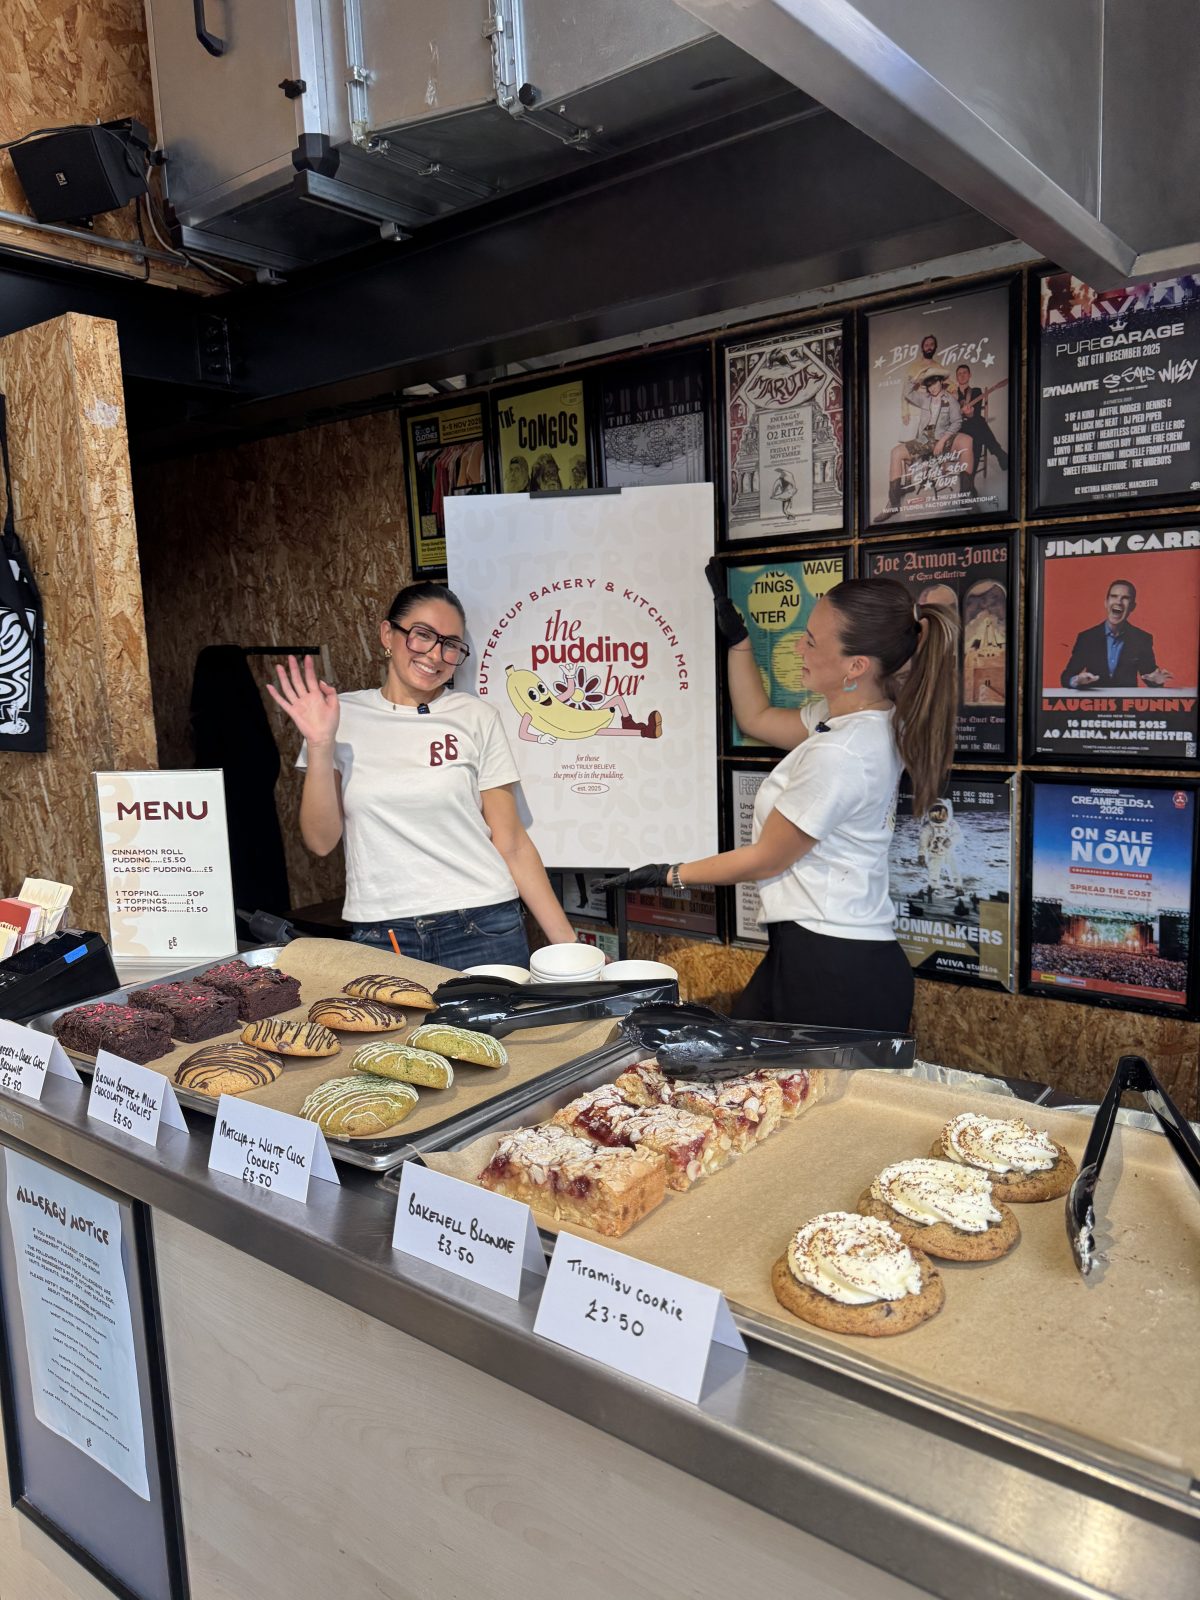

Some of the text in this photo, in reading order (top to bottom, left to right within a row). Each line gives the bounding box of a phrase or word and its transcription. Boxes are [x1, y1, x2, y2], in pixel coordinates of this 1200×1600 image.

[1077, 342, 1160, 368] SAT 6TH DECEMBER 2025
[498, 405, 516, 429] THE
[1064, 413, 1070, 422] 3
[1070, 412, 1077, 421] OF
[518, 410, 578, 451] CONGOS
[766, 426, 804, 441] O2 RITZ
[1045, 530, 1200, 557] JIMMY CARR
[803, 560, 844, 576] WAVE
[873, 546, 1008, 576] Joe Armon-Jones
[780, 594, 800, 608] AU
[480, 578, 690, 695] BUTTERCUP BAKERY & KITCHEN MCR
[545, 609, 582, 642] the
[531, 636, 648, 672] pudding
[604, 664, 645, 697] bar
[1042, 698, 1197, 712] LAUGHS FUNNY
[1043, 730, 1194, 742] AO ARENA, MANCHESTER
[1067, 720, 1168, 730] 16 DECEMBER 2025
[576, 754, 600, 763] for those
[554, 771, 562, 779] the
[563, 771, 578, 781] proof
[591, 771, 600, 779] the
[117, 801, 208, 821] MENU
[1072, 796, 1144, 808] CREAMFIELDS
[1100, 806, 1124, 816] 2026
[1070, 826, 1153, 845] ON SALE
[1072, 840, 1152, 868] NOW
[1070, 884, 1106, 893] SPREAD
[1108, 886, 1126, 895] THE
[1128, 889, 1152, 898] COST
[936, 957, 964, 969] AVIVA
[95, 1066, 115, 1088] BROWN
[142, 1092, 158, 1111] MILK
[94, 1084, 152, 1121] CHOCOLATE COOKIES
[220, 1120, 306, 1168] MATCHA + WHITE CHOC
[246, 1149, 280, 1175] COOKIES
[16, 1186, 110, 1246] ALLERGY NOTICE
[408, 1192, 516, 1254] BAKEWELL BLONDIE
[566, 1258, 632, 1296] Tiramisu
